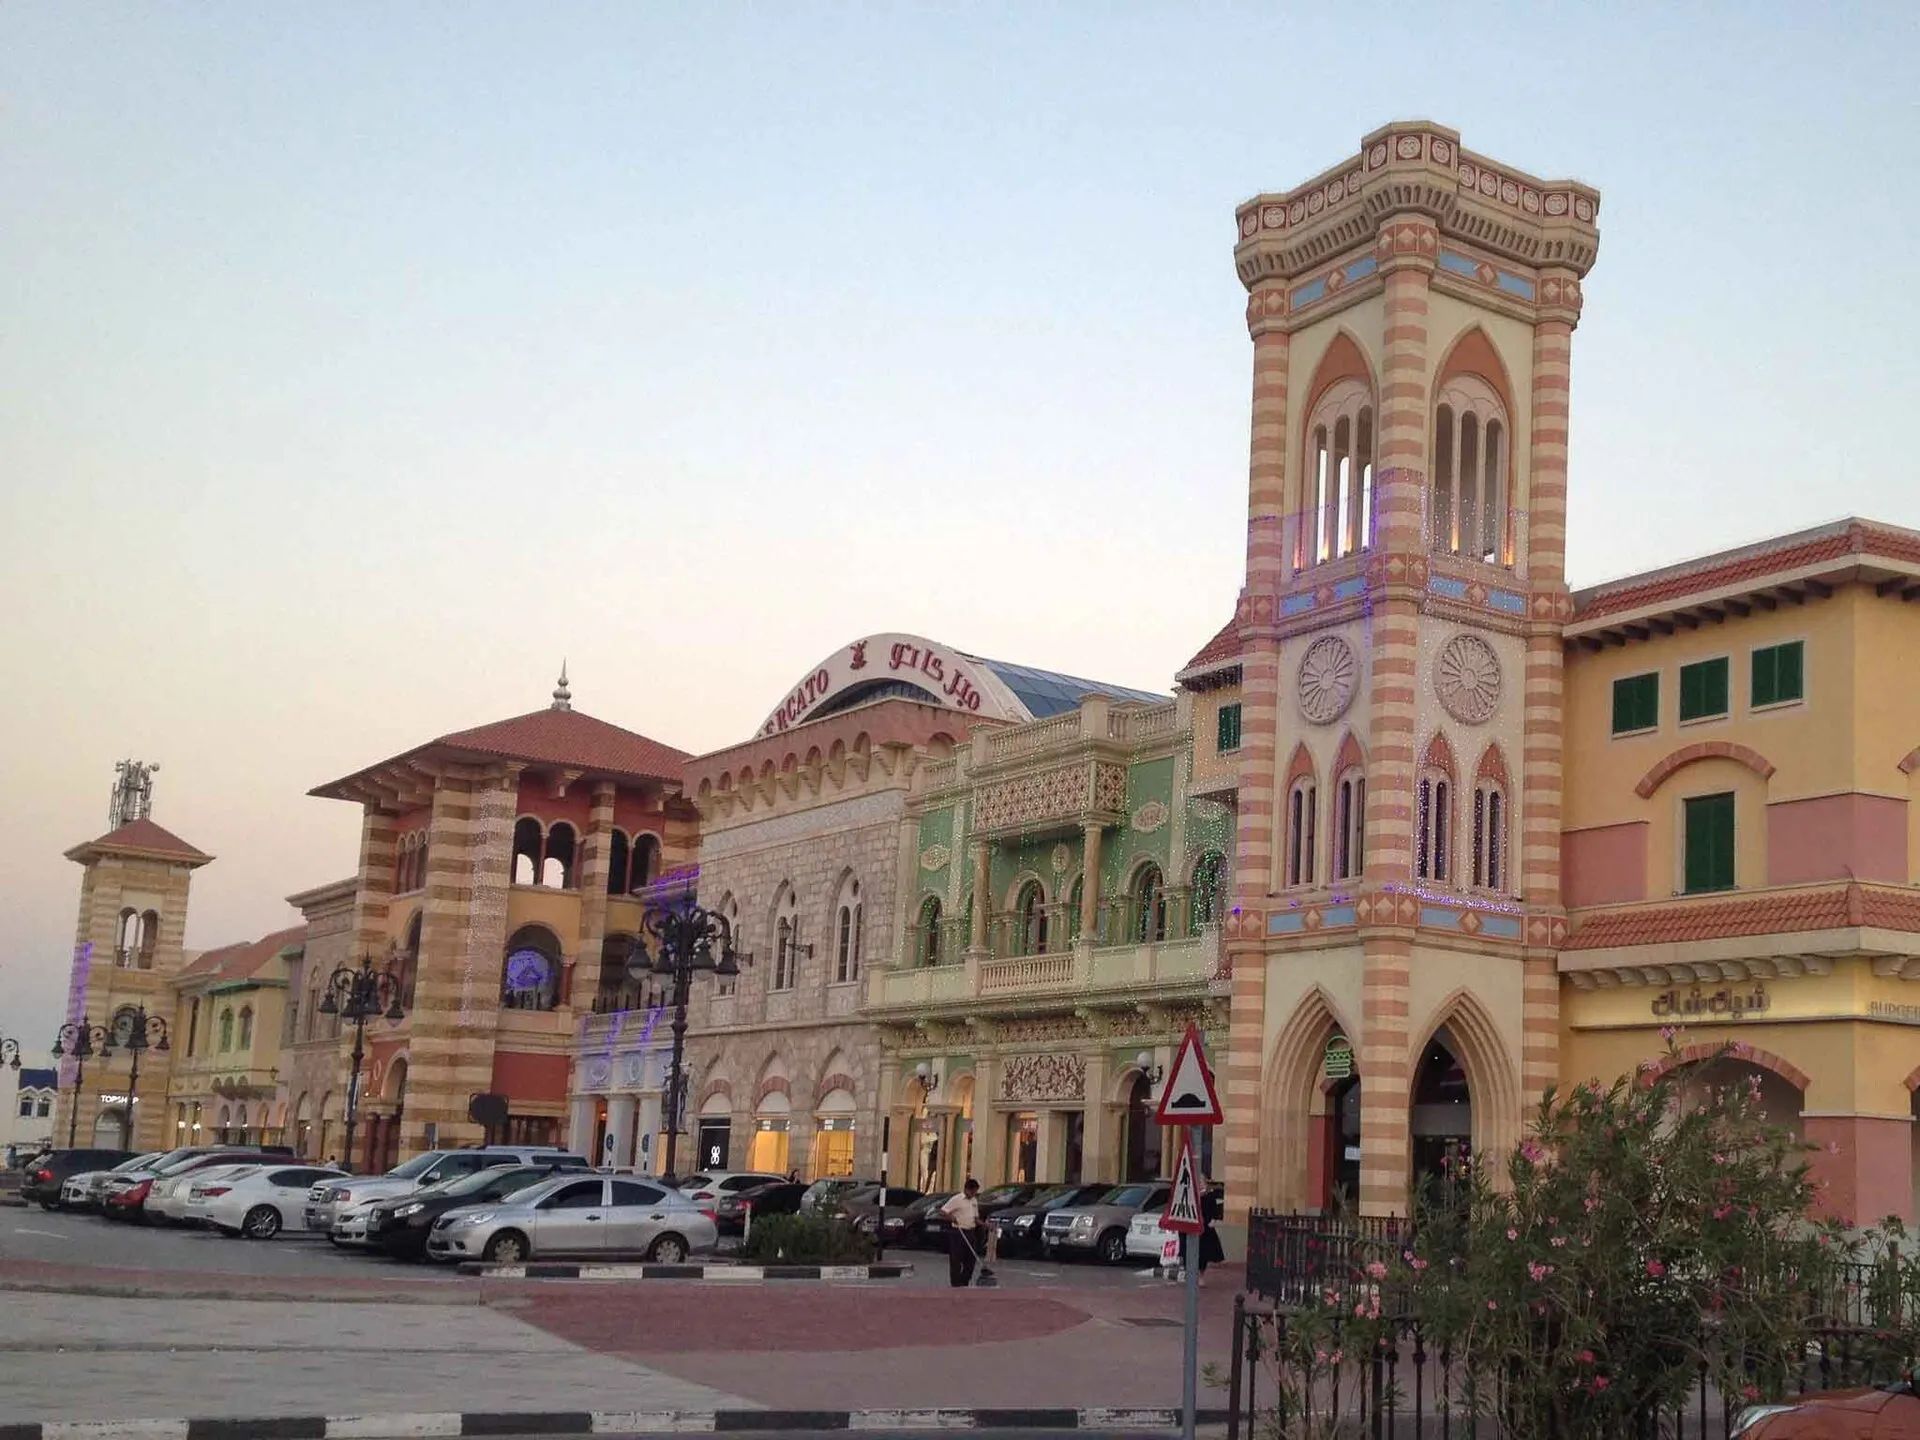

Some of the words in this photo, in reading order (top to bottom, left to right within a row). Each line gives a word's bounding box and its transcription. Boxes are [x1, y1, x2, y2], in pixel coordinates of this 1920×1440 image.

[758, 668, 829, 737] ERCATO
[889, 642, 980, 711] ميركاتو
[100, 1094, 139, 1104] TOPSHP
